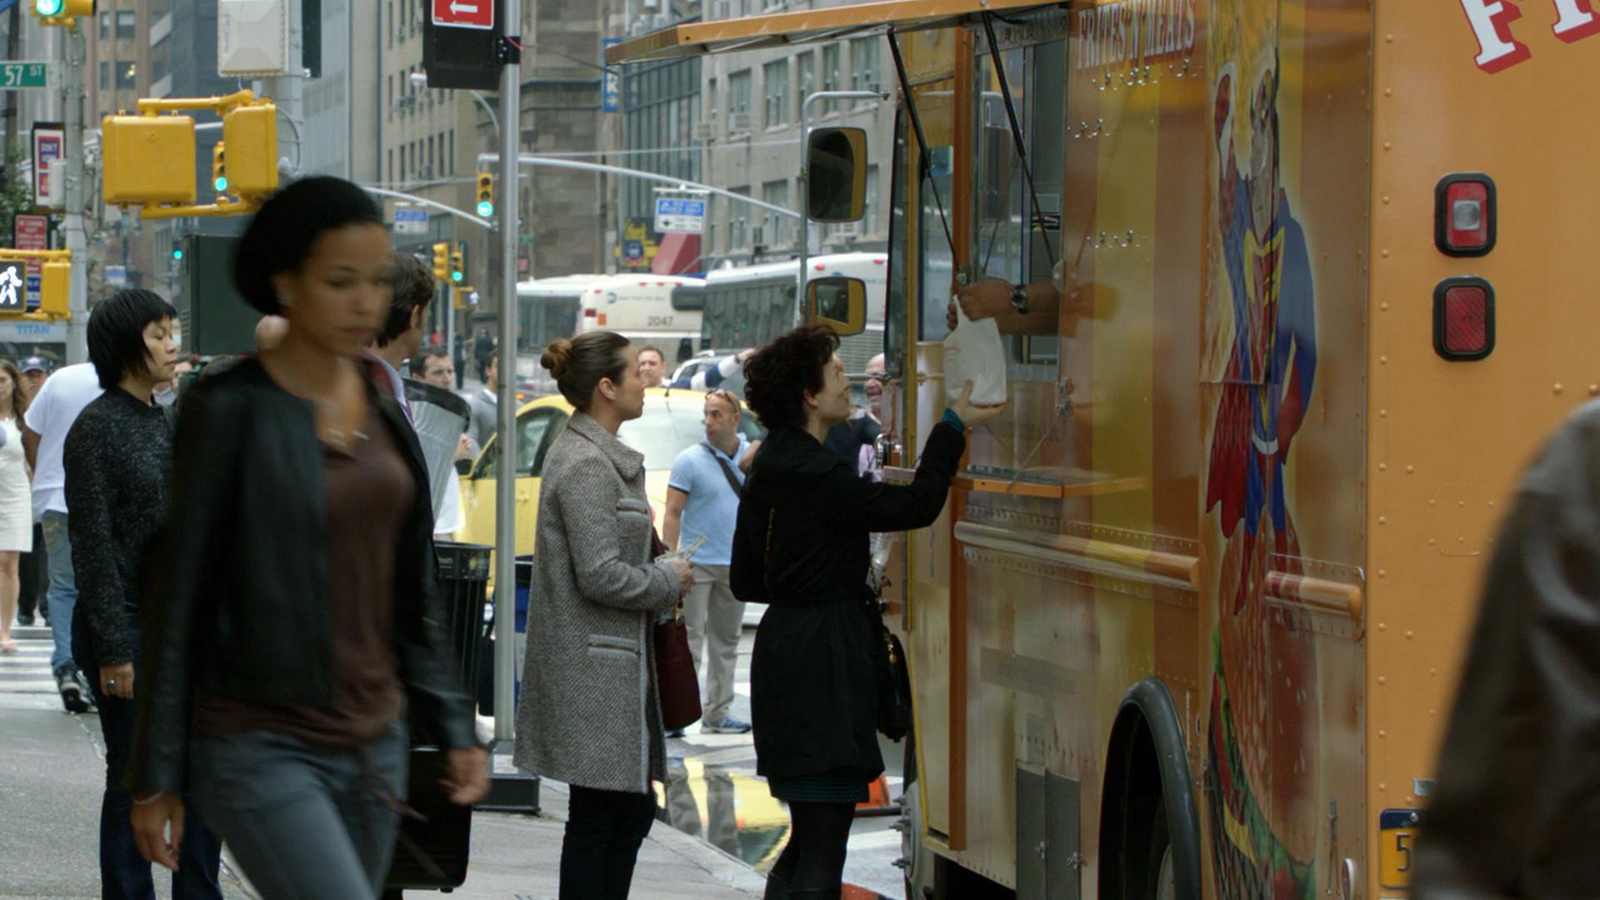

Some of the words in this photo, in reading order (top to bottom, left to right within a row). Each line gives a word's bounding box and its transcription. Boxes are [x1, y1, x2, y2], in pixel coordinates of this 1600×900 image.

[5, 65, 24, 86] 57
[30, 65, 43, 77] ST
[647, 316, 674, 327] 2047
[16, 324, 51, 334] TITAN
